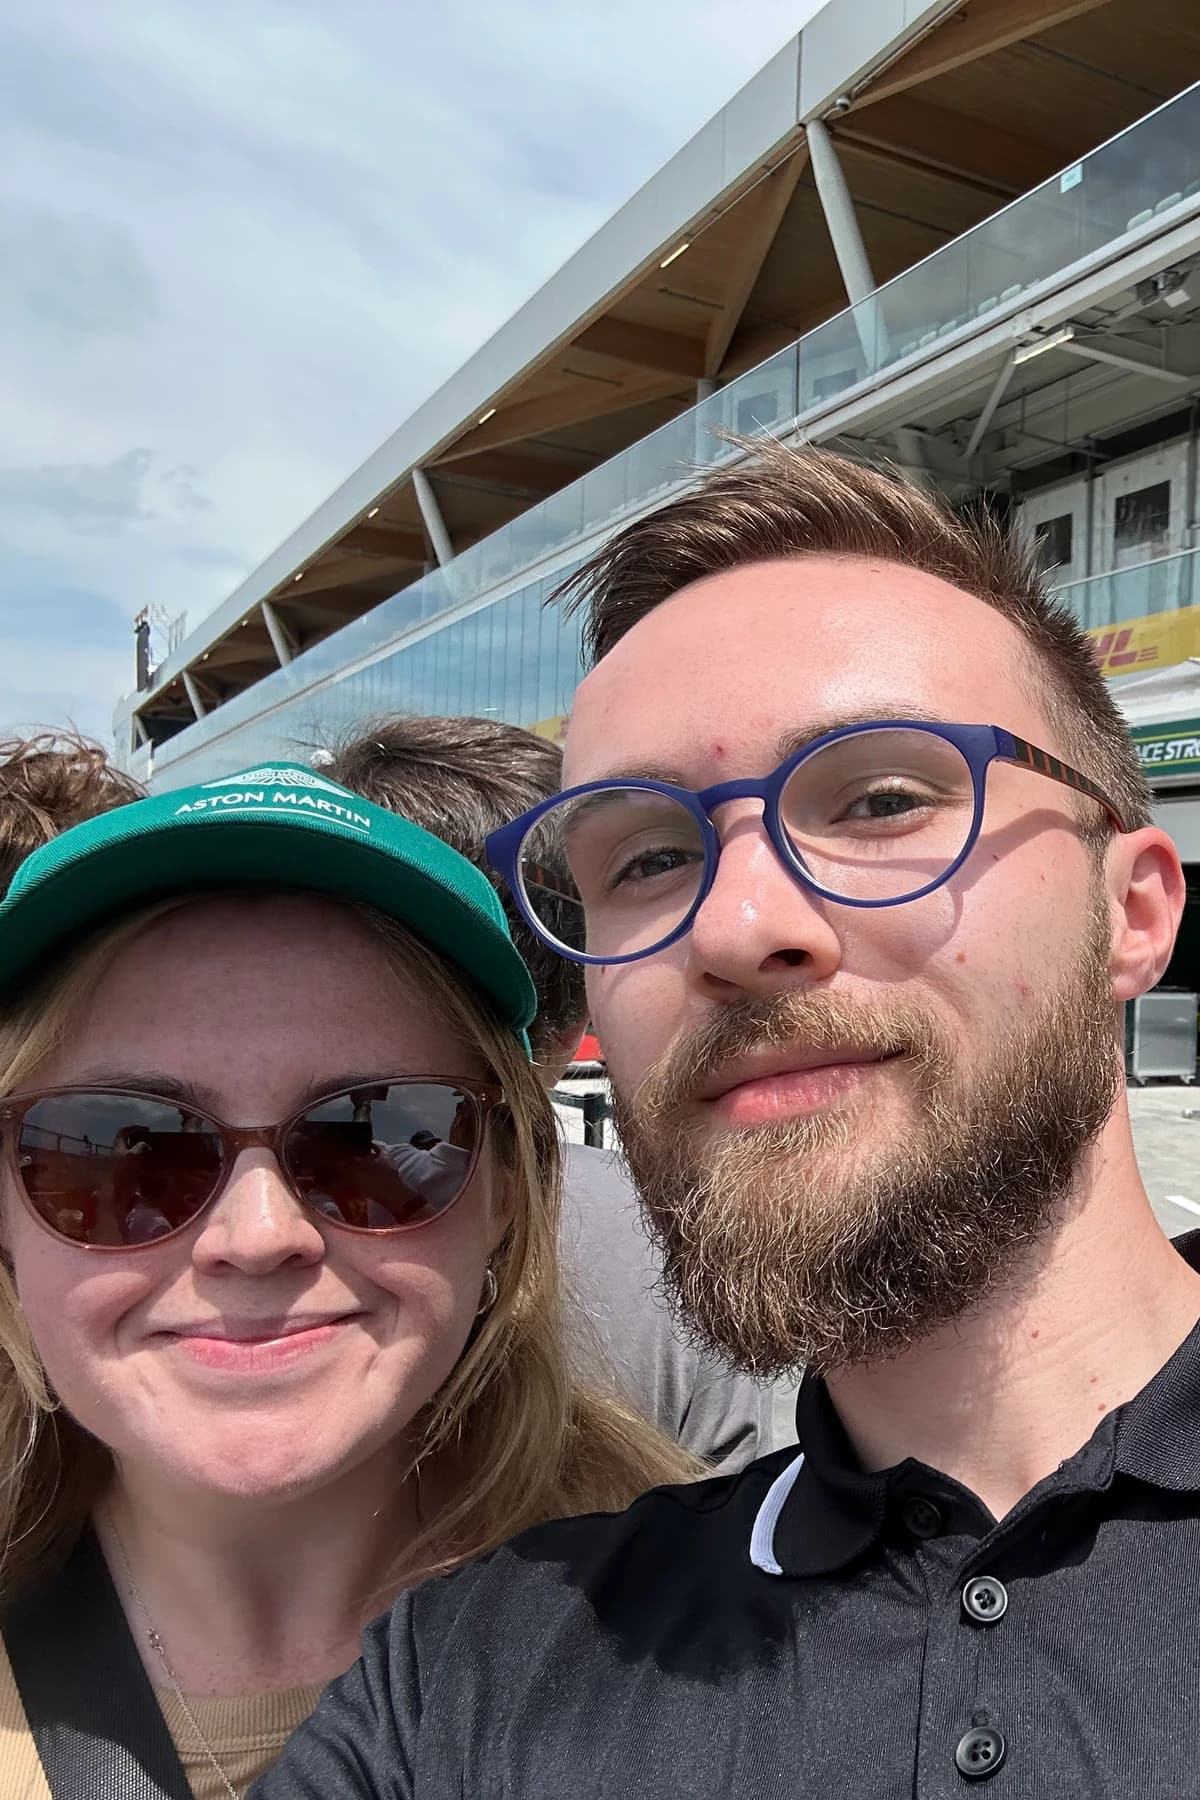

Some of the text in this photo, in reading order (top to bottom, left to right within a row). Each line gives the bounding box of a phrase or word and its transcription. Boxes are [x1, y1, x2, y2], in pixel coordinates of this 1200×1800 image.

[1096, 628, 1138, 667] HL
[175, 792, 370, 827] ASTON MARTIN
